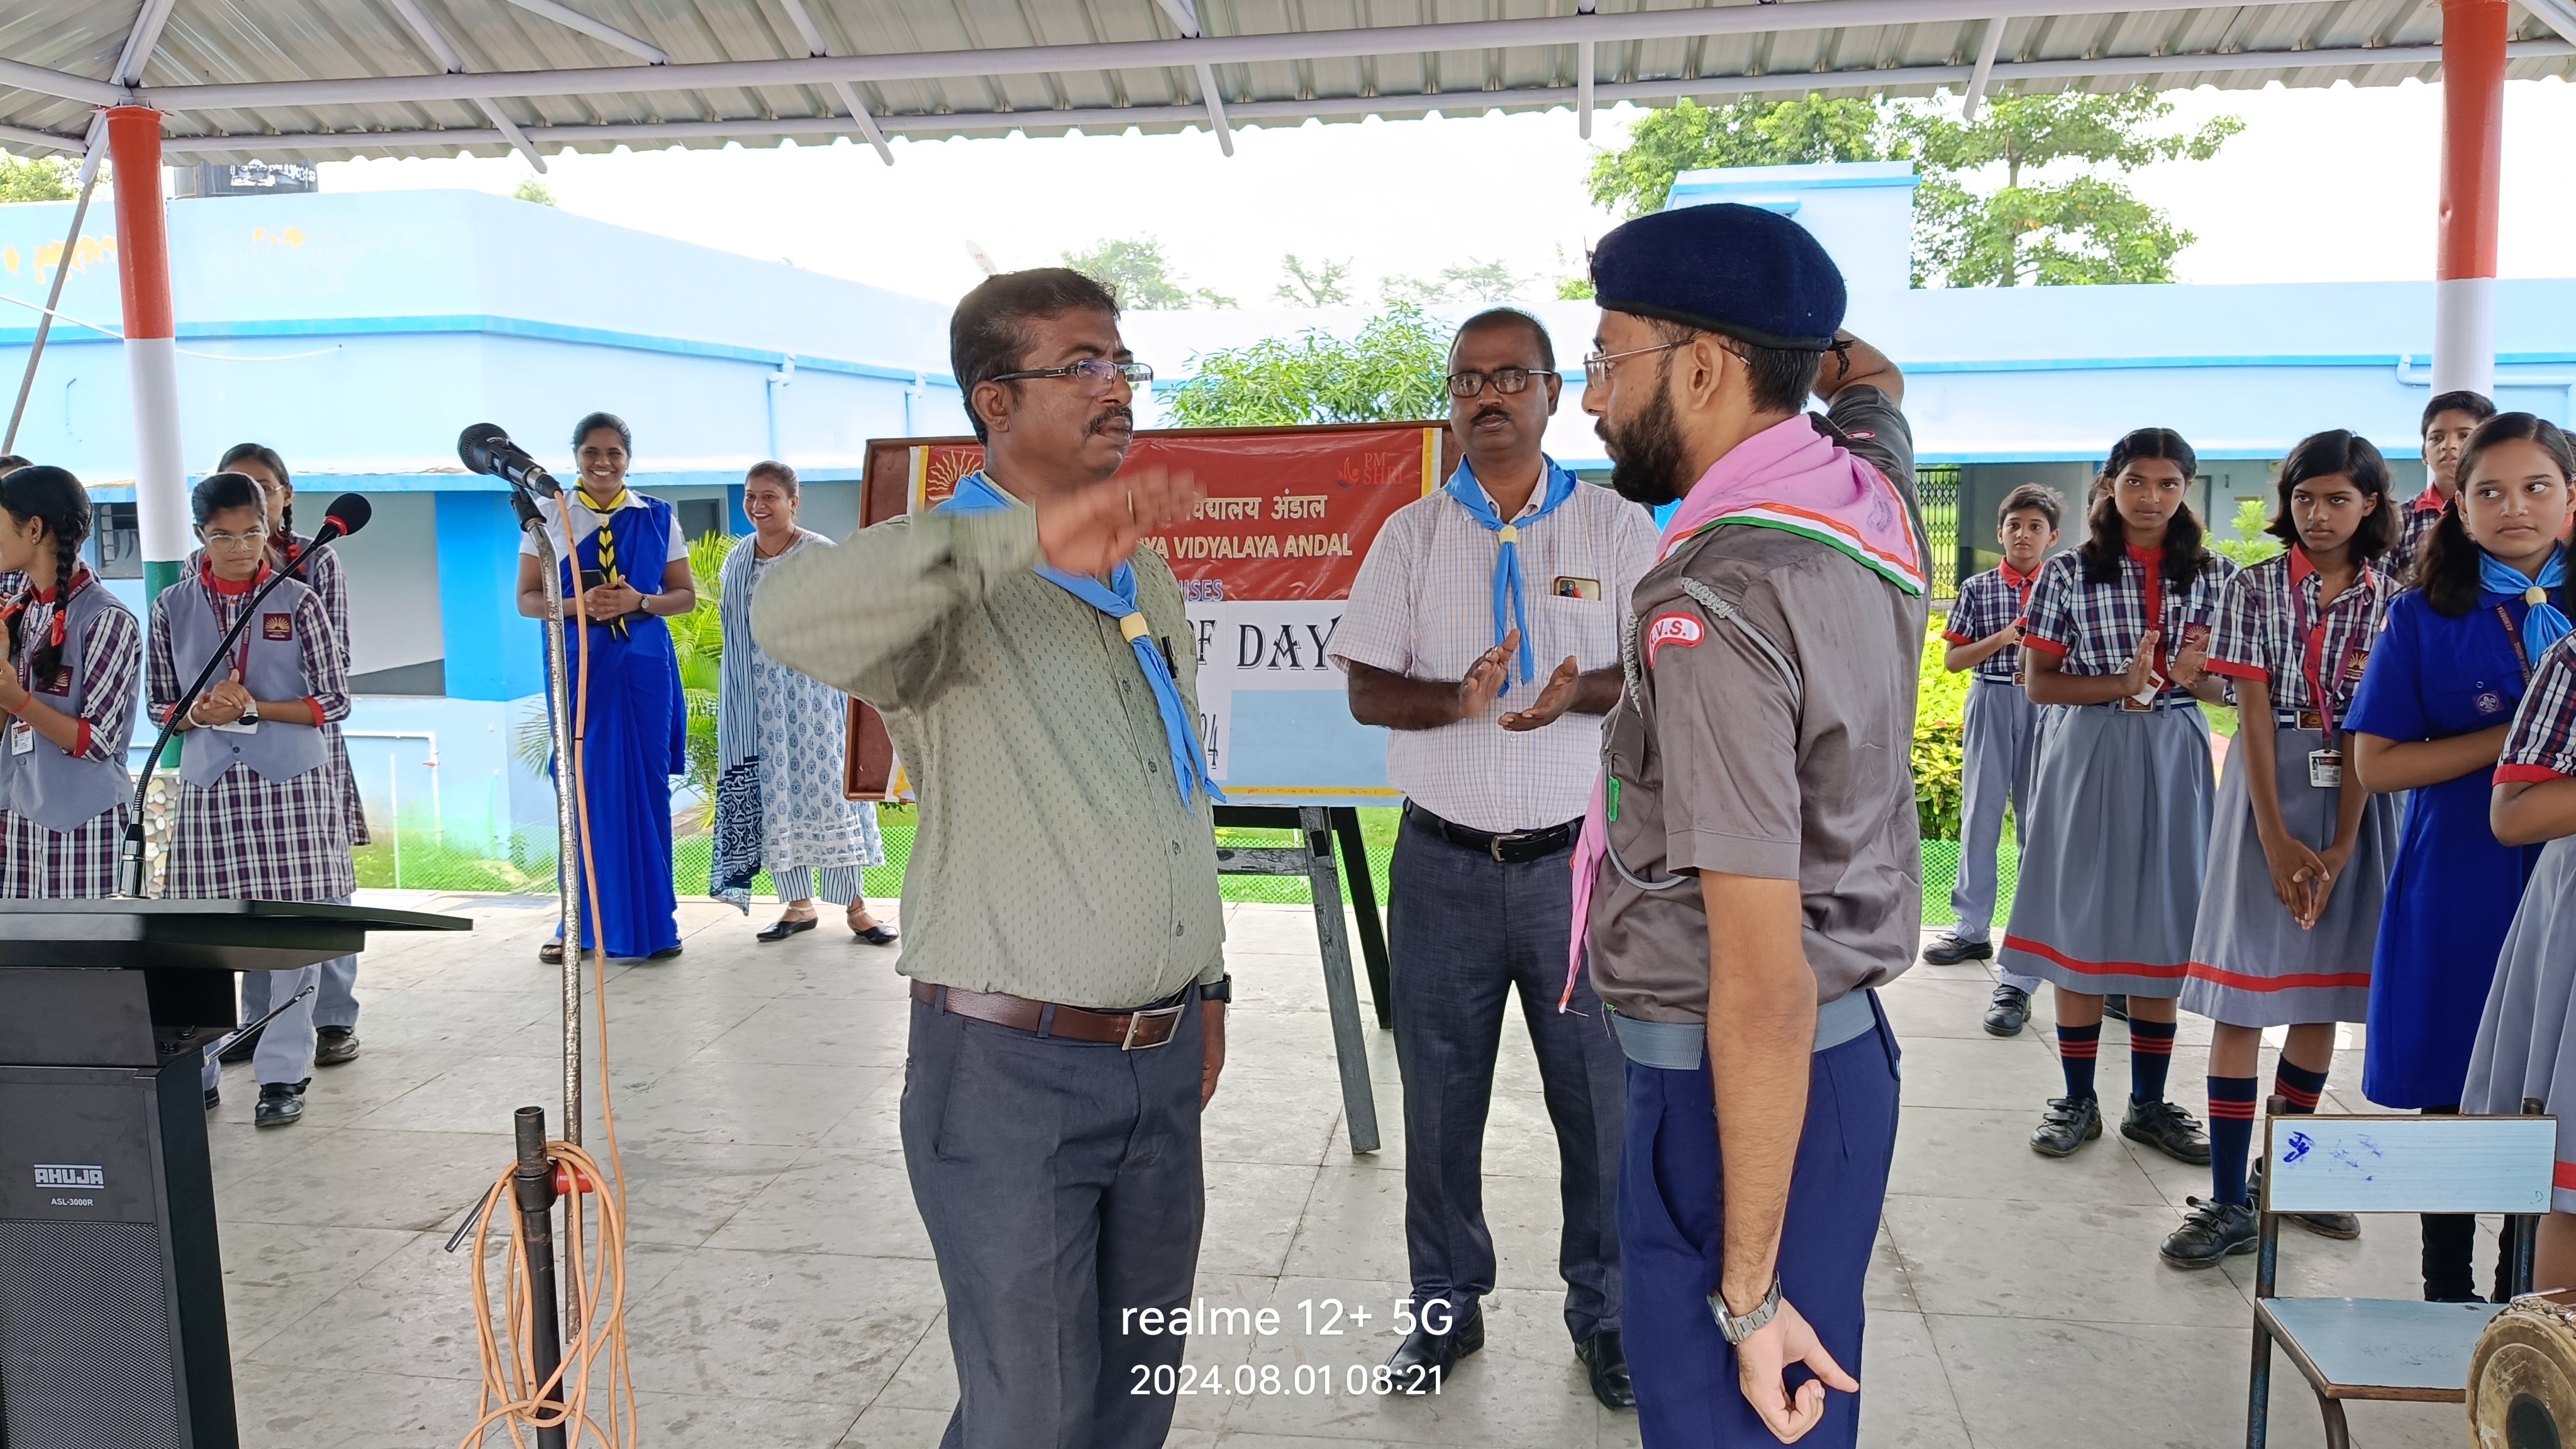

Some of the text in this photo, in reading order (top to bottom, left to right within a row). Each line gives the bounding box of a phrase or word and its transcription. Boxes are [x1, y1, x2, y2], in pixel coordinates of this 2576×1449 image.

[1364, 452, 1386, 468] PM
[1363, 466, 1403, 485] SHRI
[1270, 487, 1328, 520] अंडाल
[1173, 535, 1279, 559] VIDYALAYA
[1283, 533, 1353, 558] ANDAL
[1179, 579, 1224, 602] ISES
[1186, 613, 1343, 670] F DAY
[34, 1169, 104, 1184] AHUJA
[51, 1197, 94, 1206] ASL-3000R
